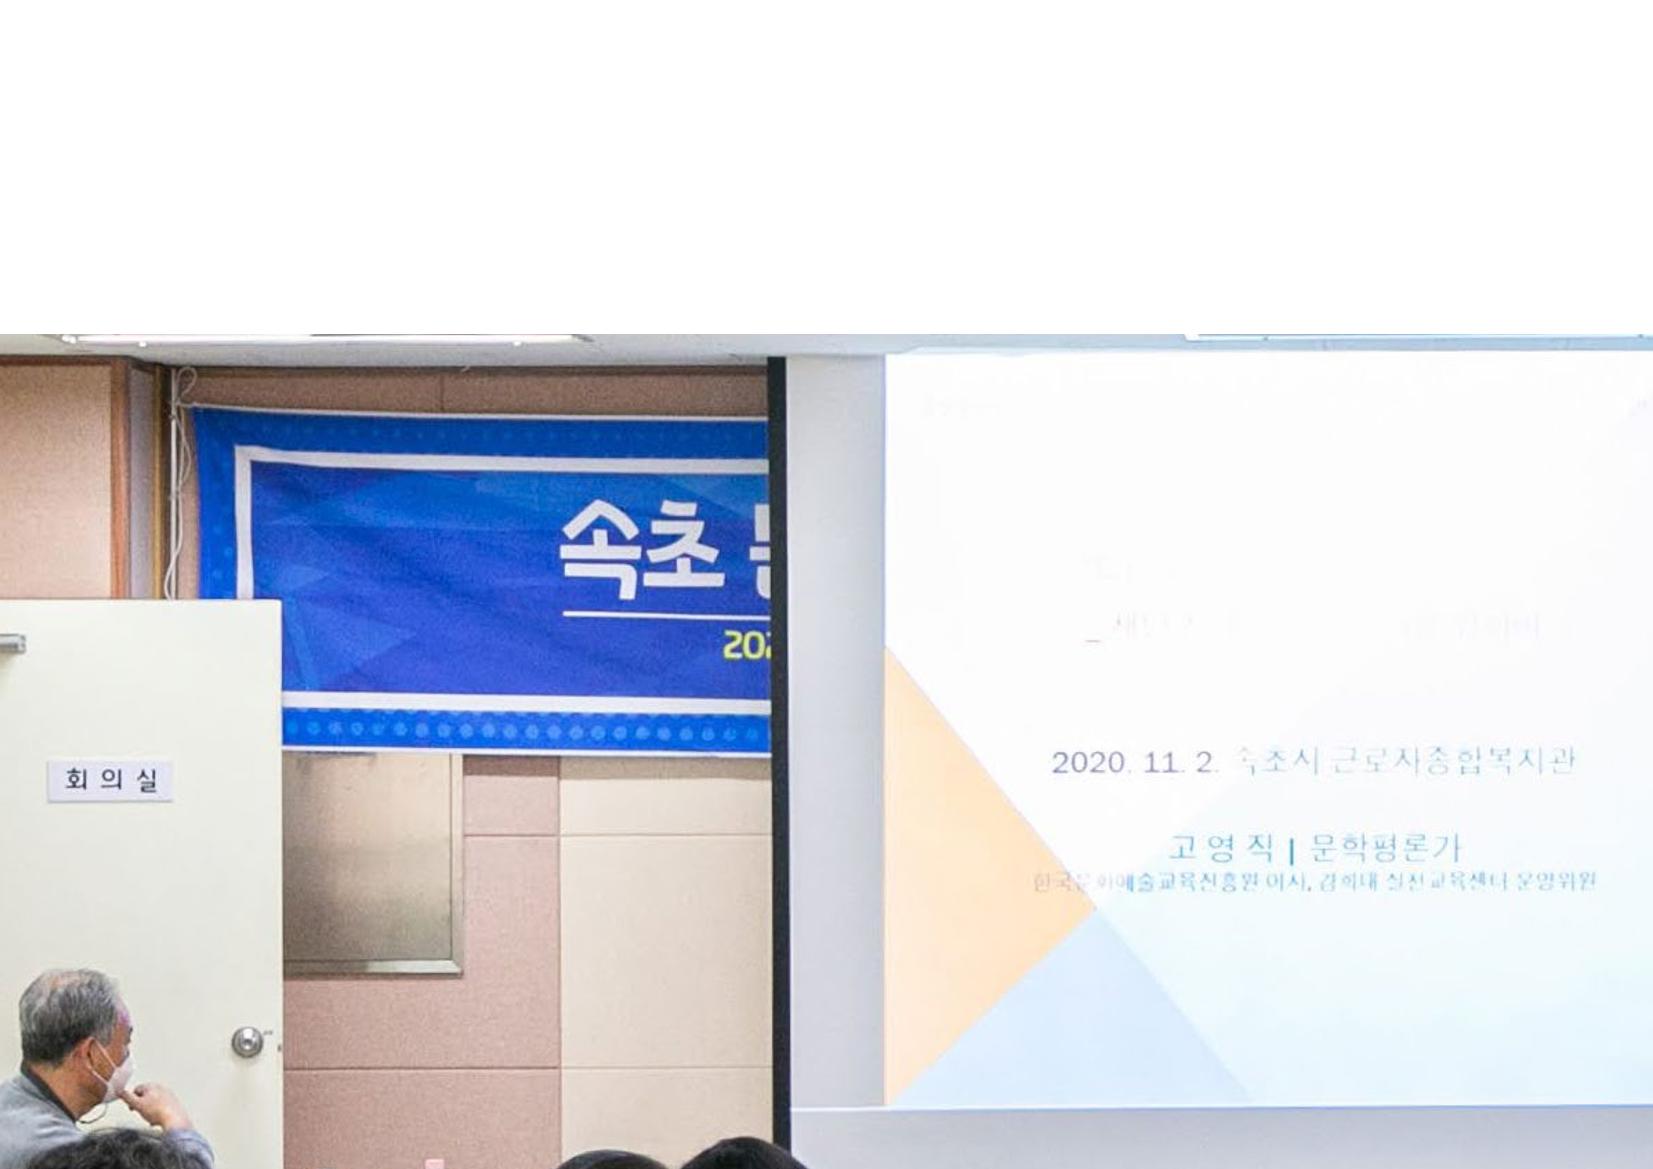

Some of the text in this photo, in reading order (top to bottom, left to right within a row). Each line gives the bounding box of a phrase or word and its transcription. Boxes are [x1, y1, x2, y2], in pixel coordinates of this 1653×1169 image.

[560, 499, 726, 600] 속초
[1051, 750, 1132, 775] 2020.
[1144, 751, 1186, 775] 11.
[1331, 745, 1578, 778] 근로자종합복지관
[1310, 832, 1463, 864] 문학평론가
